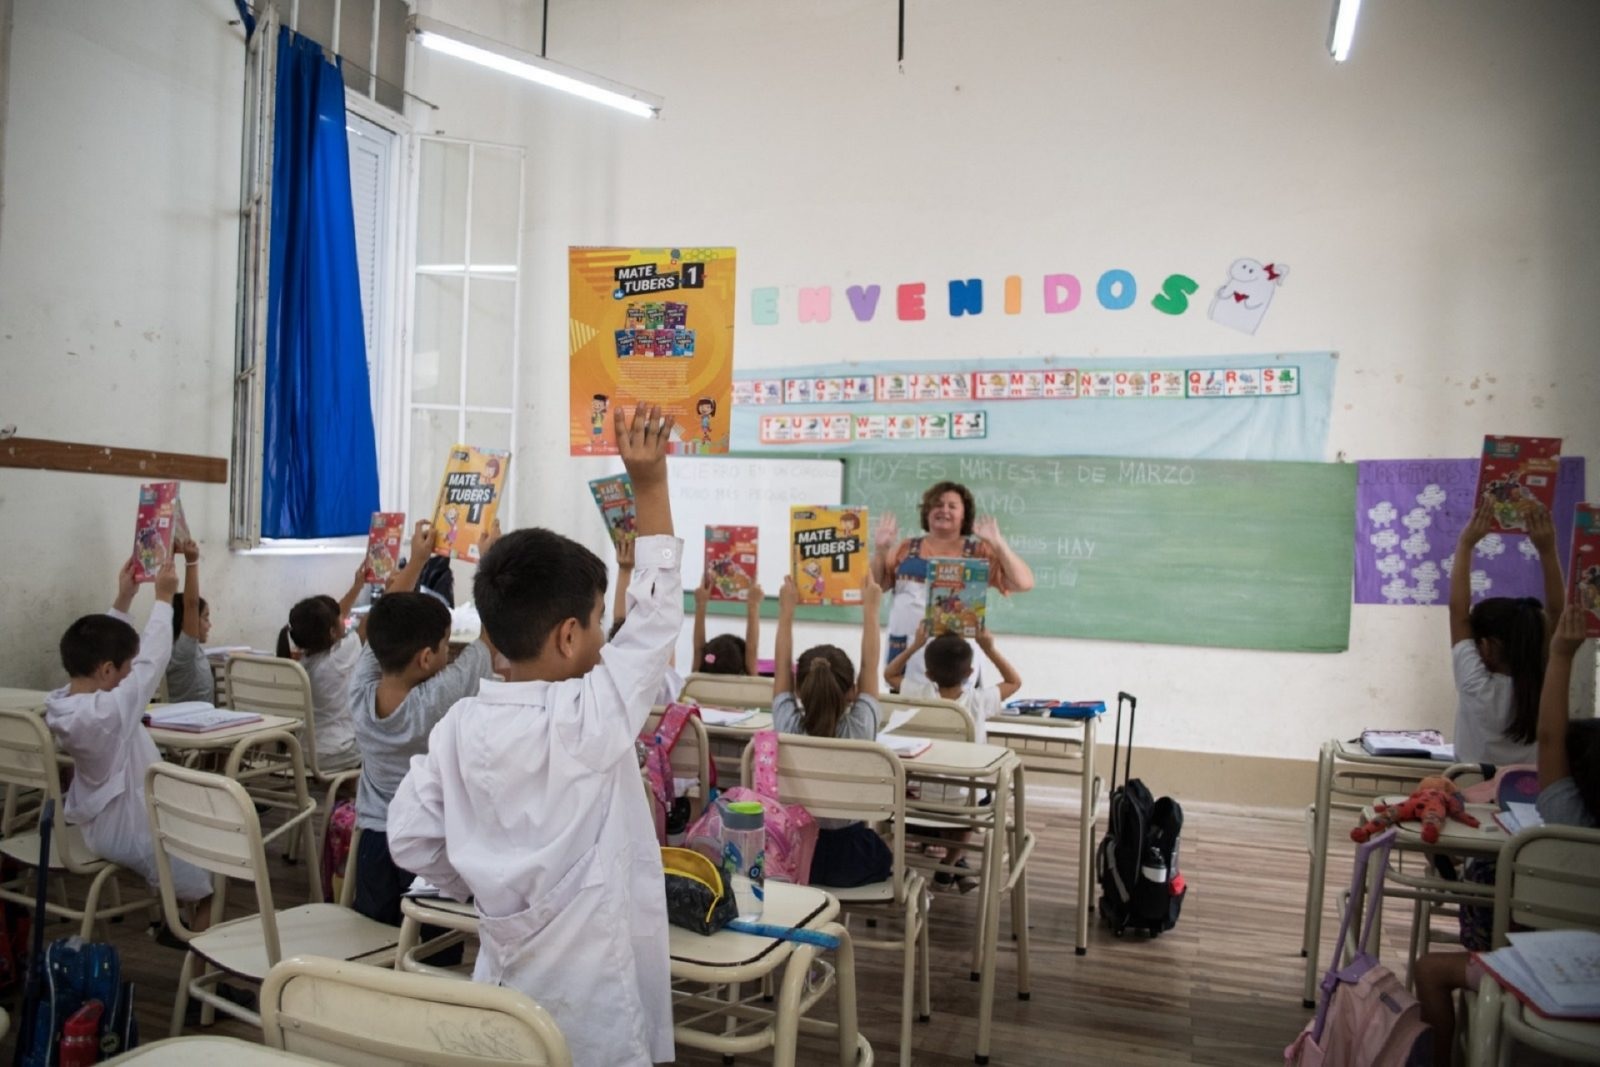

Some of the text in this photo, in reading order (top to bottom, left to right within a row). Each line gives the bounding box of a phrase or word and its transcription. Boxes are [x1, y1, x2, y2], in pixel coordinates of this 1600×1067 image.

[618, 265, 653, 280] MATE
[687, 266, 697, 285] 1
[624, 277, 676, 293] TUBERS
[857, 457, 1197, 486] HOY ES MARTES 7 DE MARZO
[448, 474, 477, 486] MATE
[450, 488, 491, 501] TUBERS
[472, 503, 480, 521] 1
[798, 529, 833, 543] MATE
[804, 540, 856, 557] TUBERS
[1057, 536, 1096, 559] HAY
[835, 554, 845, 570] 1
